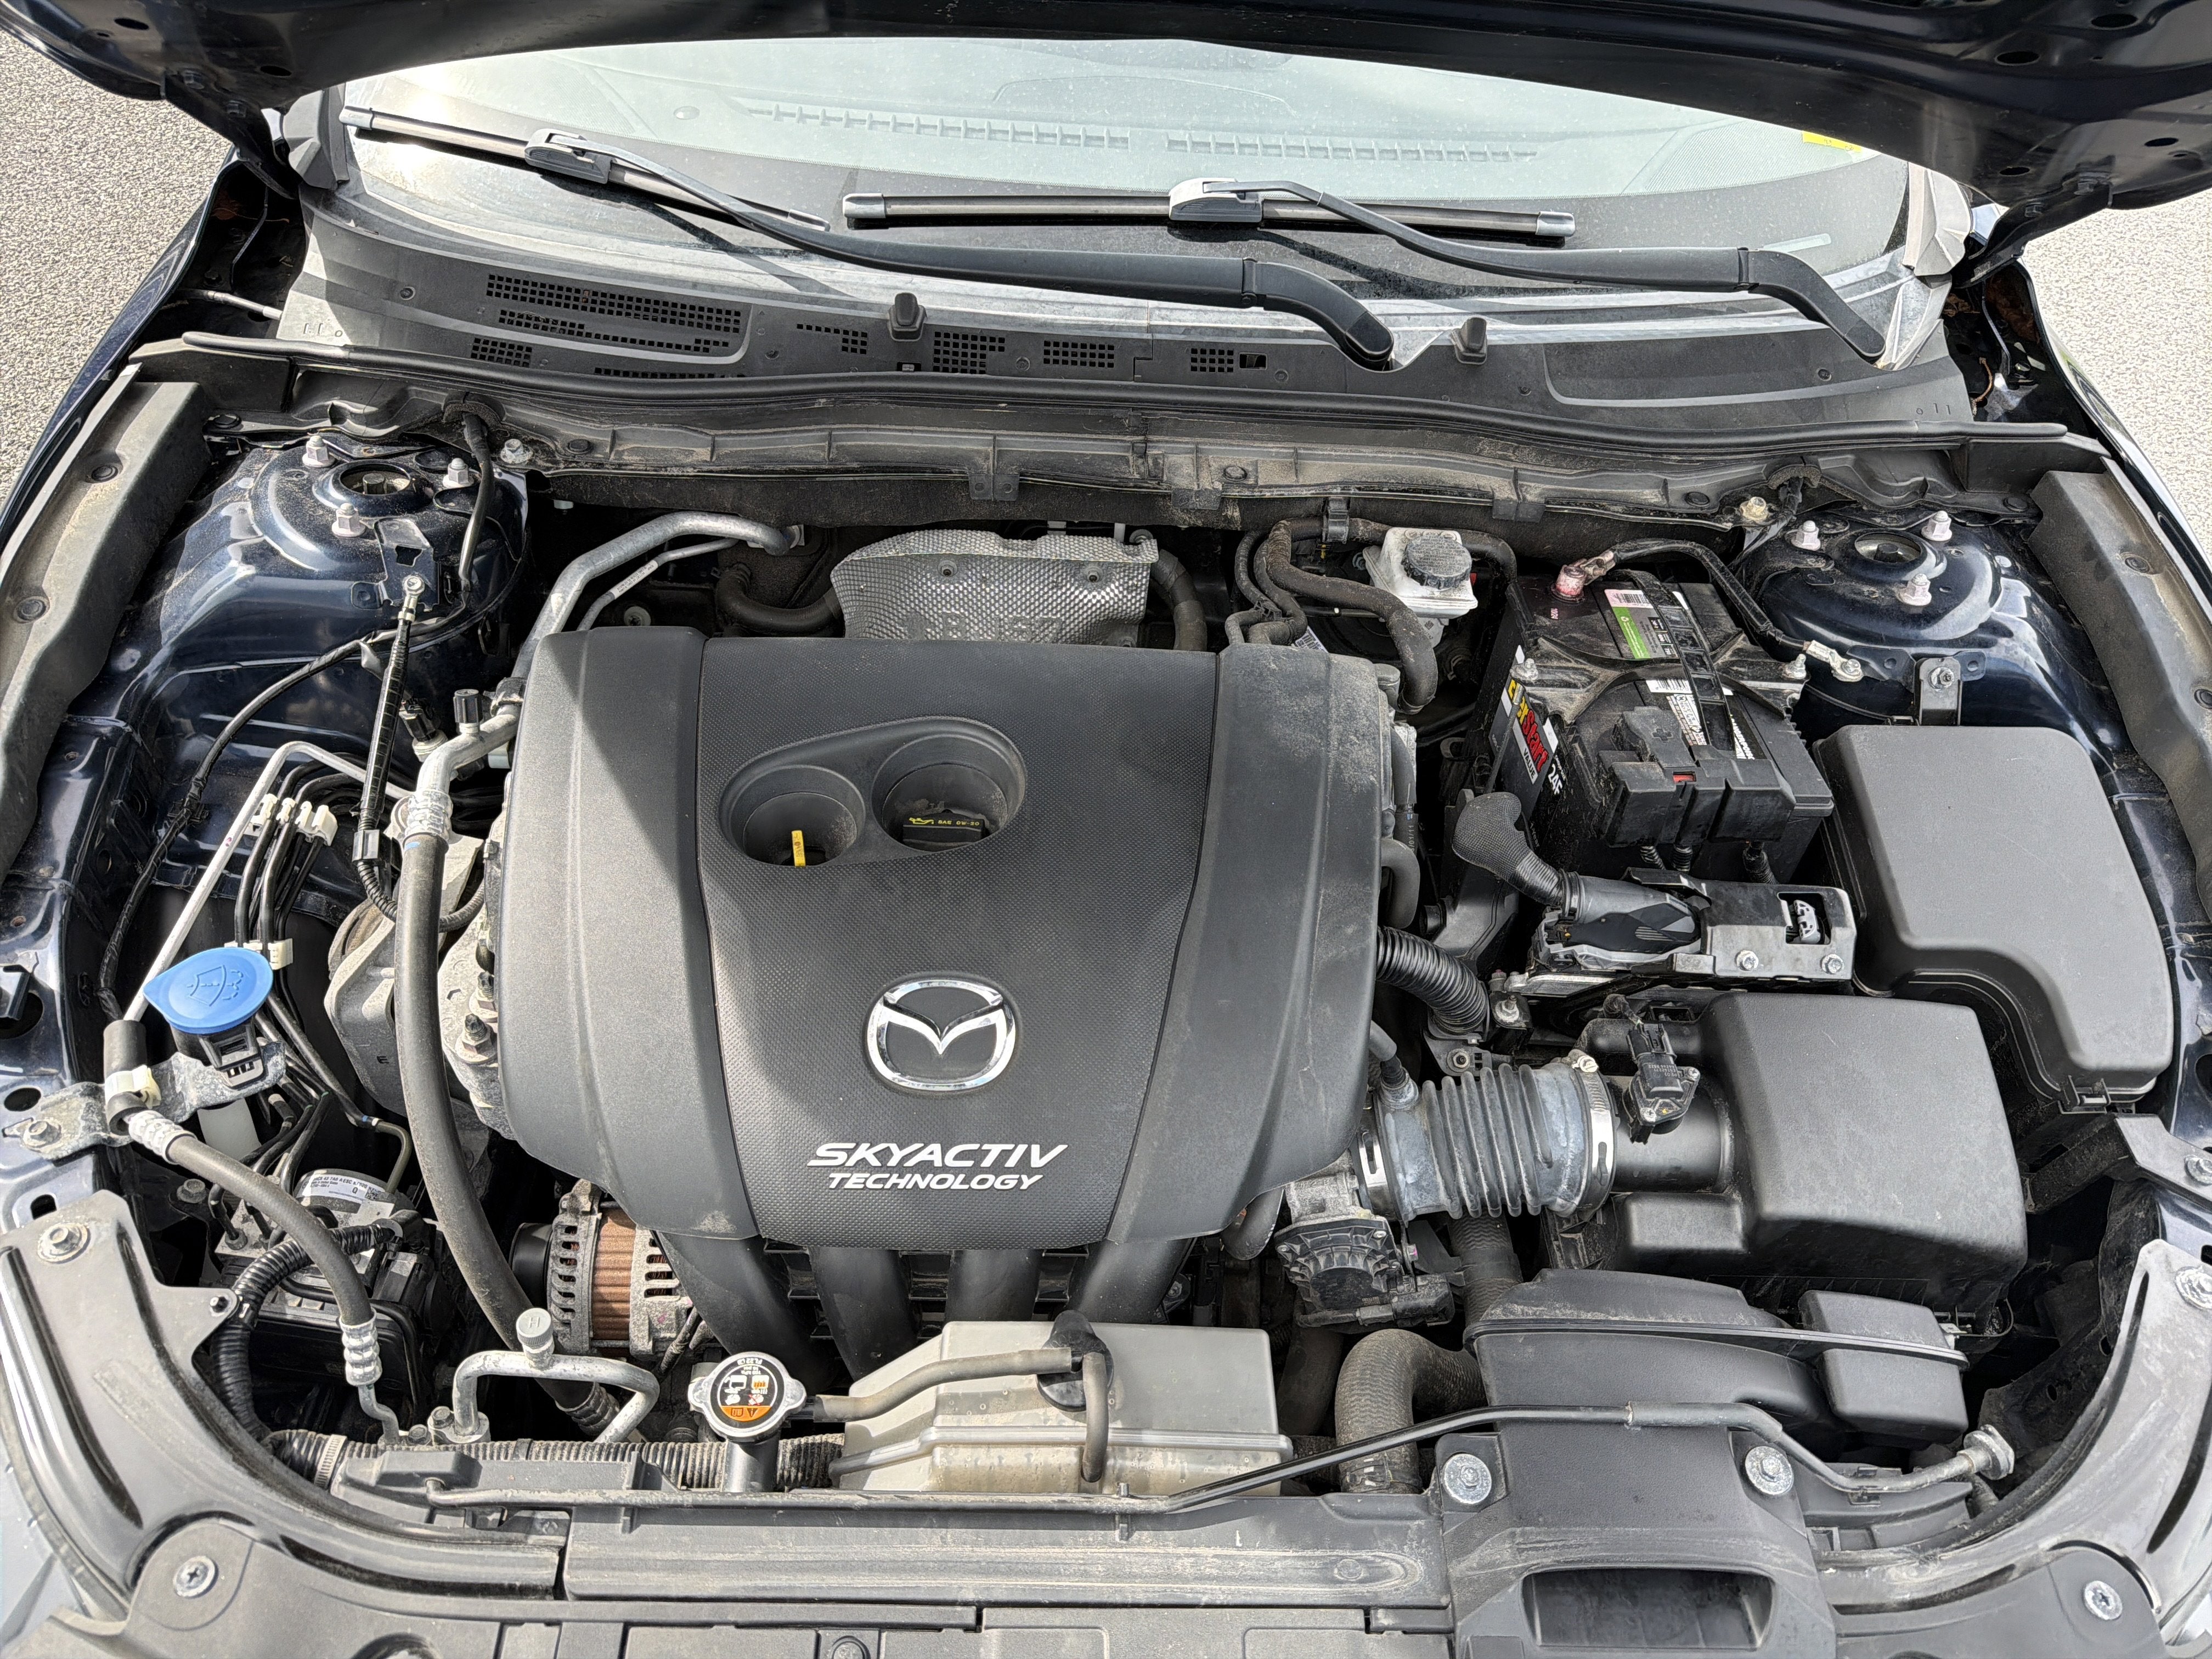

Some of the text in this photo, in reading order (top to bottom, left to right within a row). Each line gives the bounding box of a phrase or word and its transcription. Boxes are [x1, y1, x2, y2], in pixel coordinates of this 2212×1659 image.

[1508, 679, 1549, 772] ErStart
[1523, 748, 1536, 780] VALUE
[1548, 764, 1562, 795] 24F
[806, 1143, 1069, 1168] SKYACTIV
[828, 1173, 1043, 1190] TECHNOLOGY
[528, 1316, 541, 1329] H
